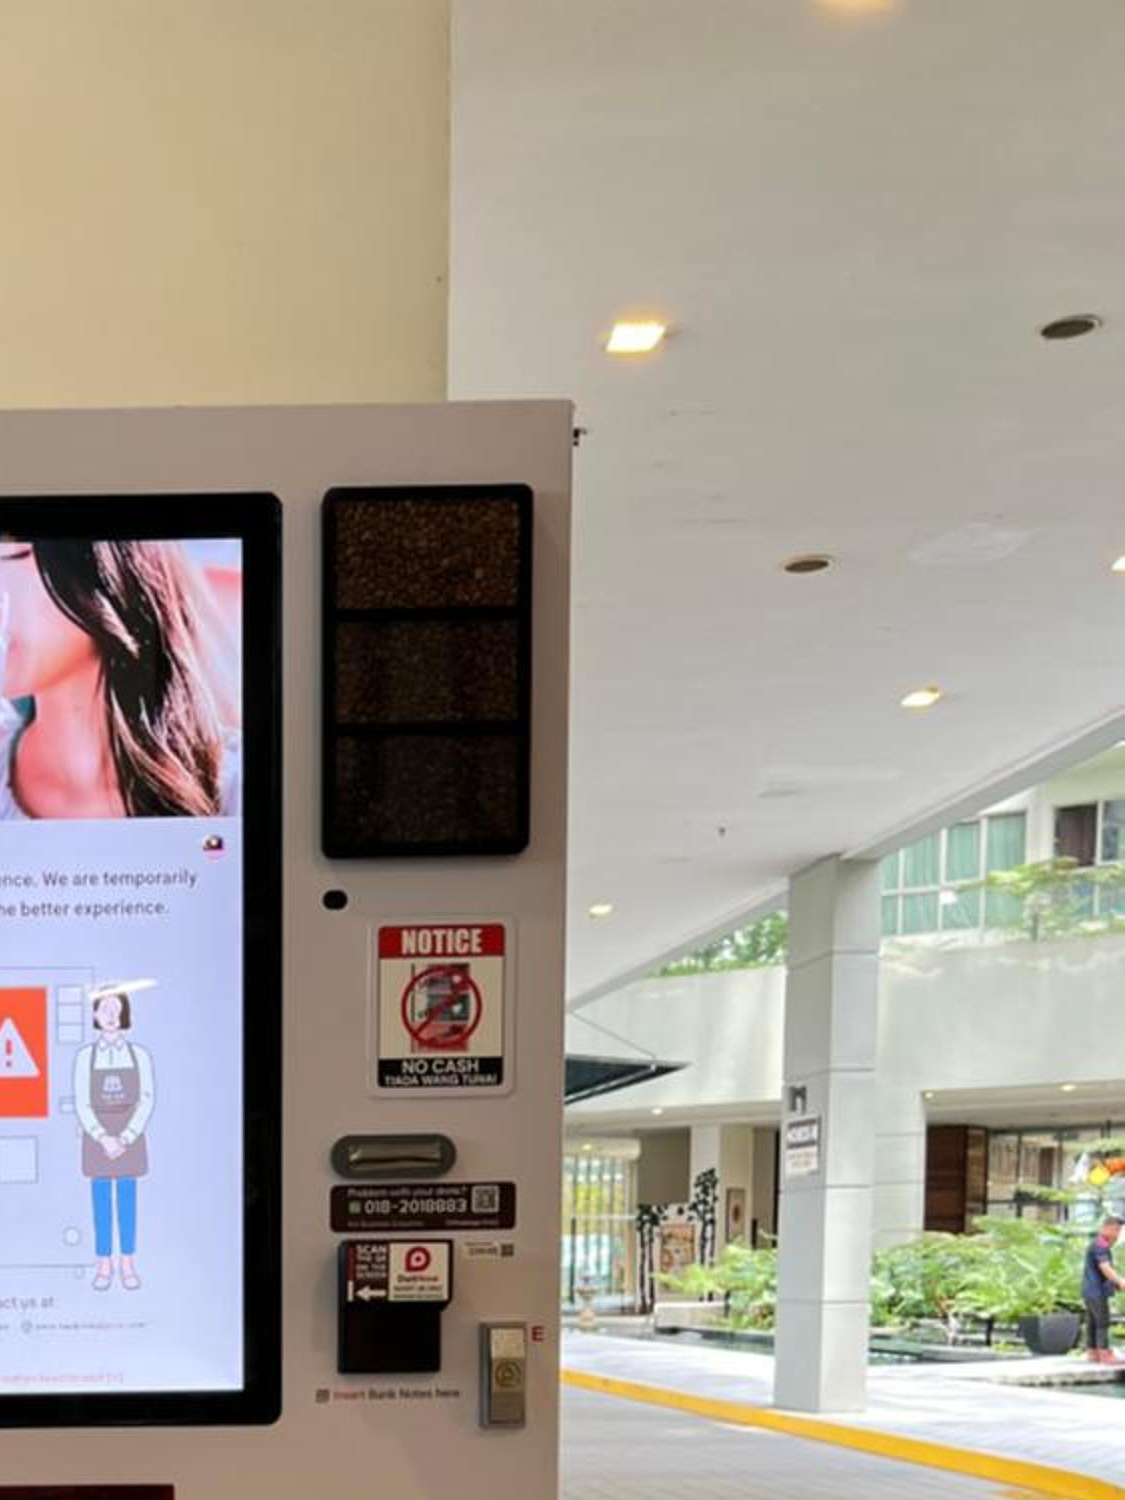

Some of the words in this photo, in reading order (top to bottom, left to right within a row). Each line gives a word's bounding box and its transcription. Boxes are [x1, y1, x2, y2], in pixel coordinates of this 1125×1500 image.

[42, 871, 70, 887] We
[74, 874, 100, 887] are
[103, 868, 197, 888] temporarily
[20, 901, 70, 917] better
[74, 901, 171, 920] experience.
[400, 928, 483, 955] NOTICE
[400, 1058, 429, 1074] NO
[431, 1058, 480, 1073] CASH
[421, 1073, 460, 1086] WANG
[20, 1298, 37, 1310] us
[40, 1296, 55, 1309] at
[530, 1326, 546, 1342] E
[332, 1389, 366, 1401] Insert
[368, 1388, 396, 1400] Bank
[399, 1387, 433, 1400] Notes
[435, 1387, 460, 1399] here
